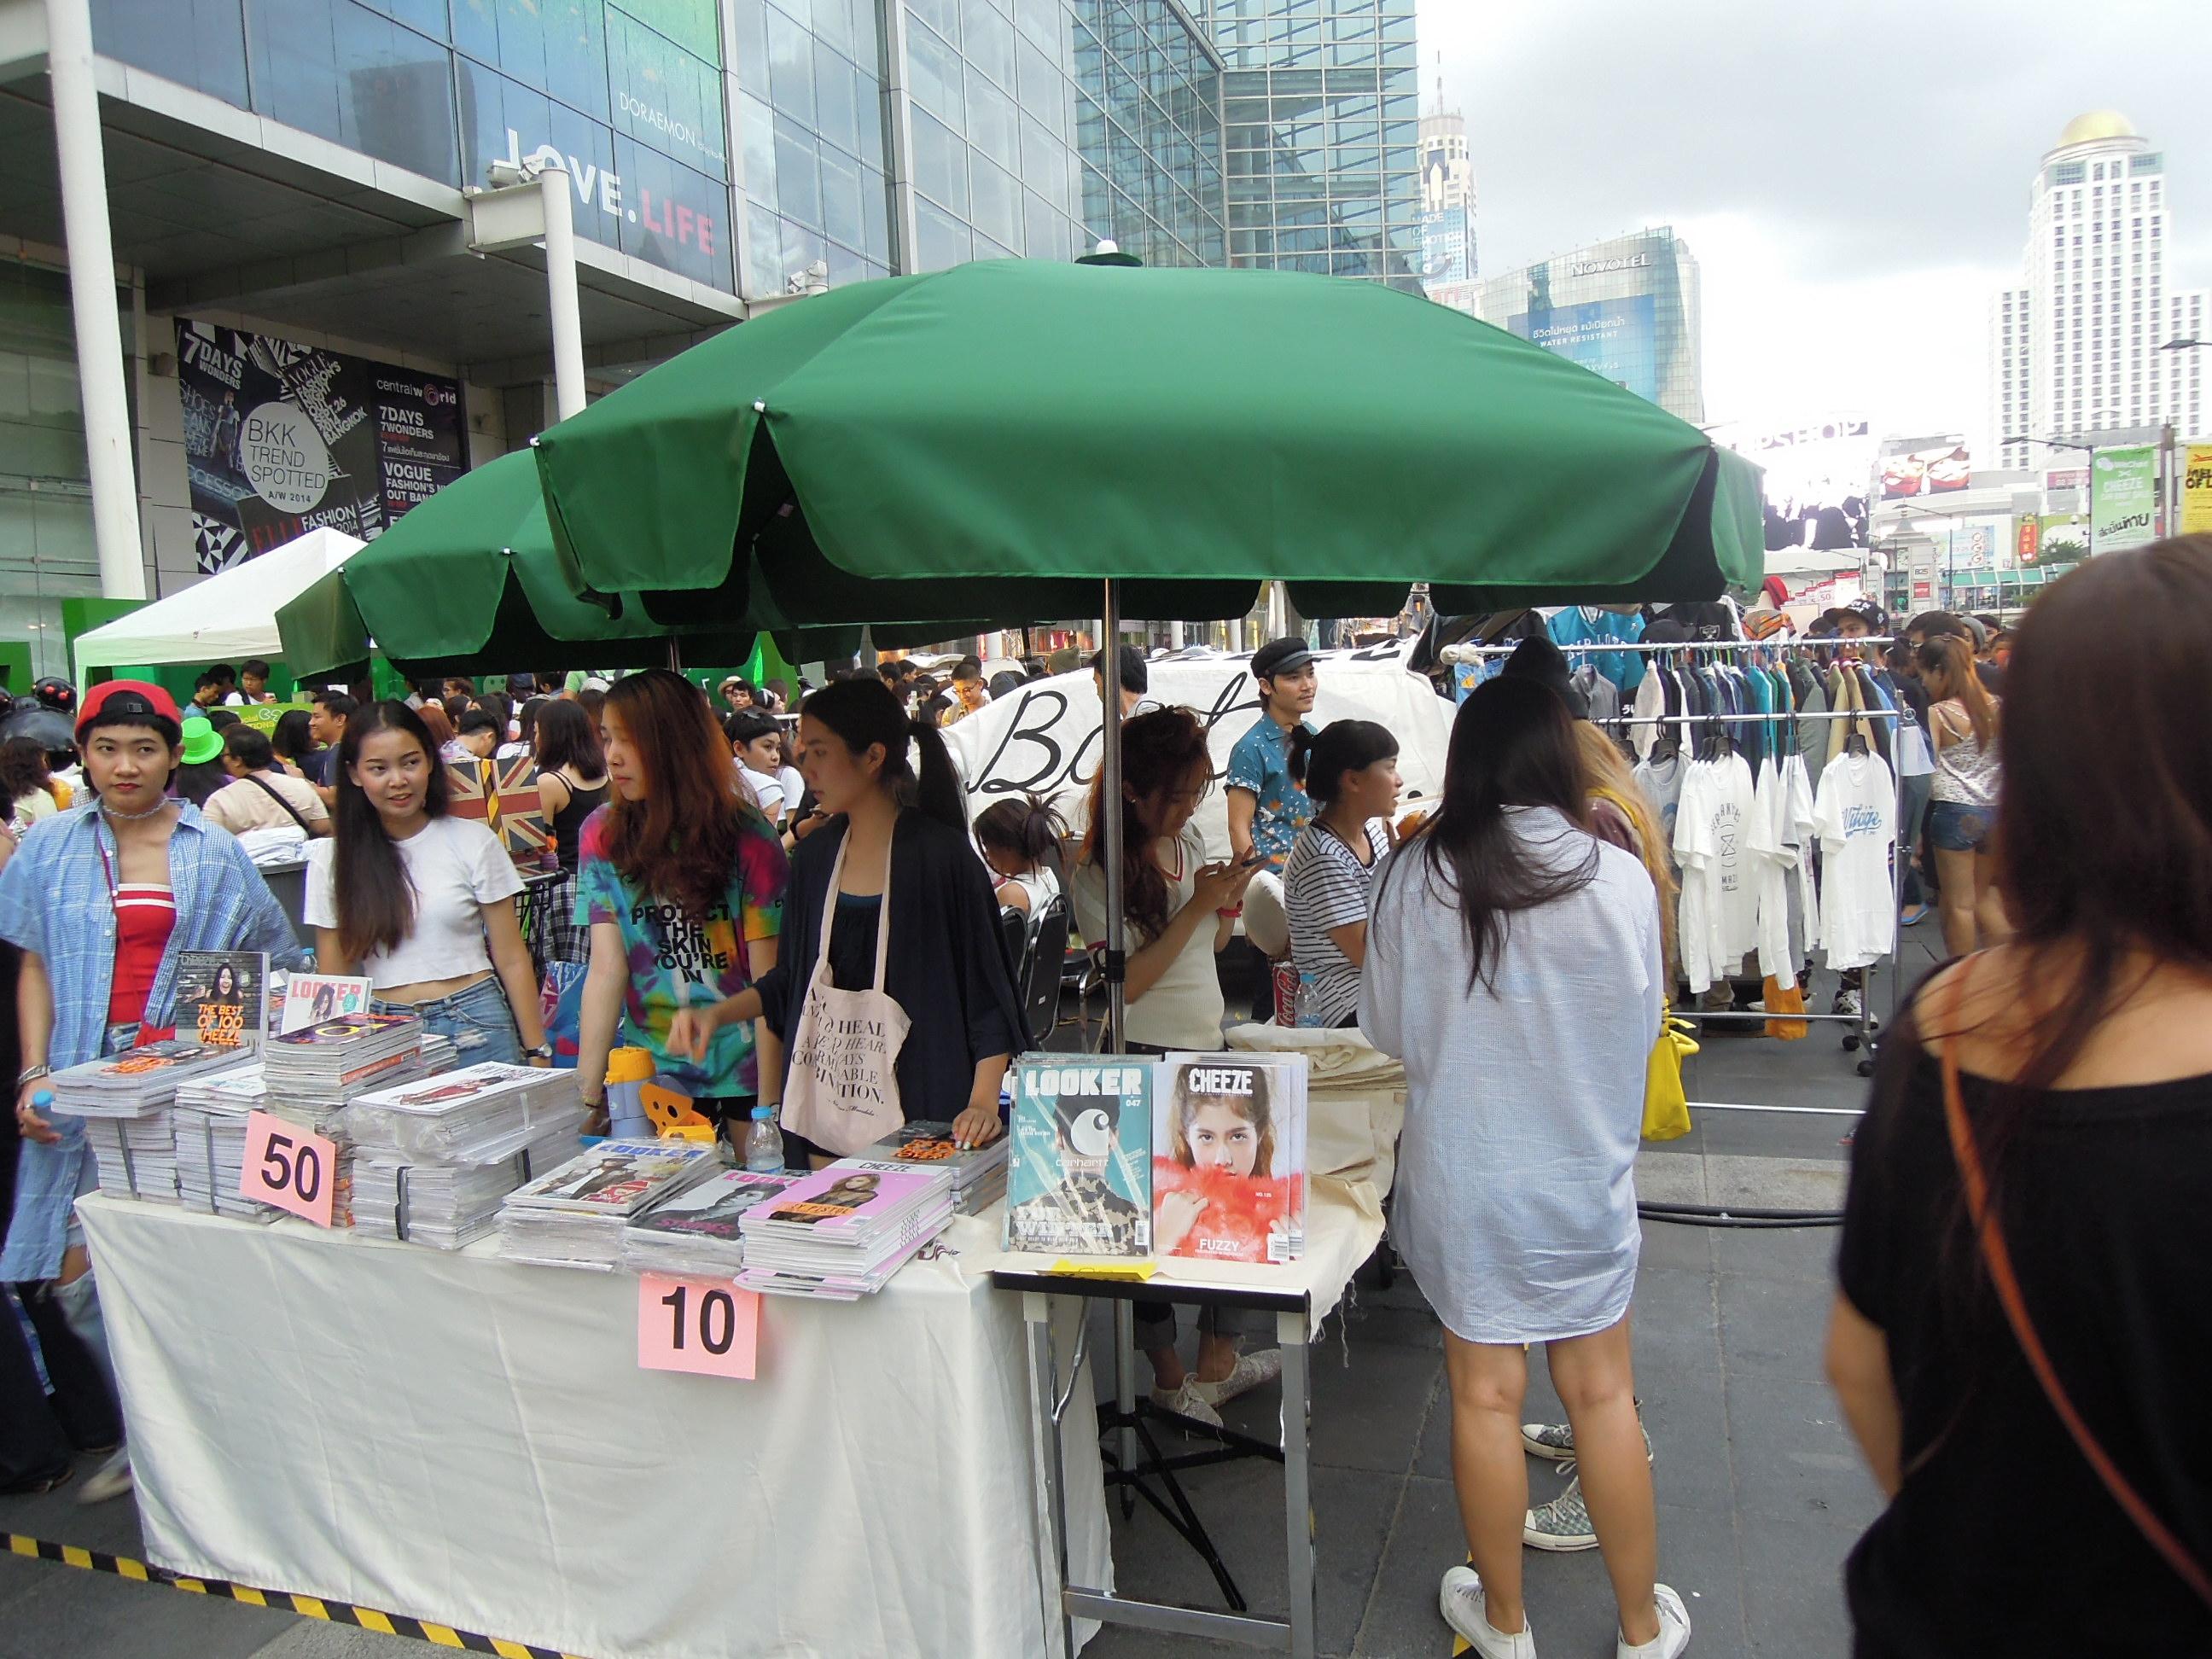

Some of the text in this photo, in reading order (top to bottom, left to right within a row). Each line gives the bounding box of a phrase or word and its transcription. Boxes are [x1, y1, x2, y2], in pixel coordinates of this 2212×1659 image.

[620, 91, 696, 147] DORAEMON
[1571, 253, 1651, 277] NOVOTEL
[1540, 330, 1619, 348] WATER RESISTANT
[183, 331, 244, 380] 7 DAYS
[198, 359, 242, 392] WONDERS
[248, 418, 296, 447] BKK
[323, 406, 368, 445] BANGKOK
[250, 445, 306, 468] TREND
[251, 465, 326, 489] SPOTTED
[383, 462, 434, 482] VOGUE
[386, 478, 436, 493] FASHION'S
[2185, 478, 2203, 489] OF
[268, 490, 311, 503] A/W 2014
[387, 490, 407, 502] OUT
[301, 504, 358, 532] FASHION
[631, 904, 729, 926] PROCT
[656, 921, 705, 939] THE
[659, 937, 712, 955] SKIN
[680, 969, 705, 984] IN
[292, 981, 363, 1001] LOOER
[199, 1004, 244, 1016] THE BEST
[197, 1015, 244, 1030] OF 100
[1025, 1068, 1143, 1097] LOOKER
[1189, 1068, 1254, 1095] CHEEZE
[1126, 1098, 1141, 1107] 047
[261, 1132, 321, 1202] 50
[859, 1162, 917, 1173] CHEEZE
[1056, 1157, 1109, 1168] carhartt
[1200, 1238, 1241, 1252] FUZZY
[661, 1285, 736, 1356] 10
